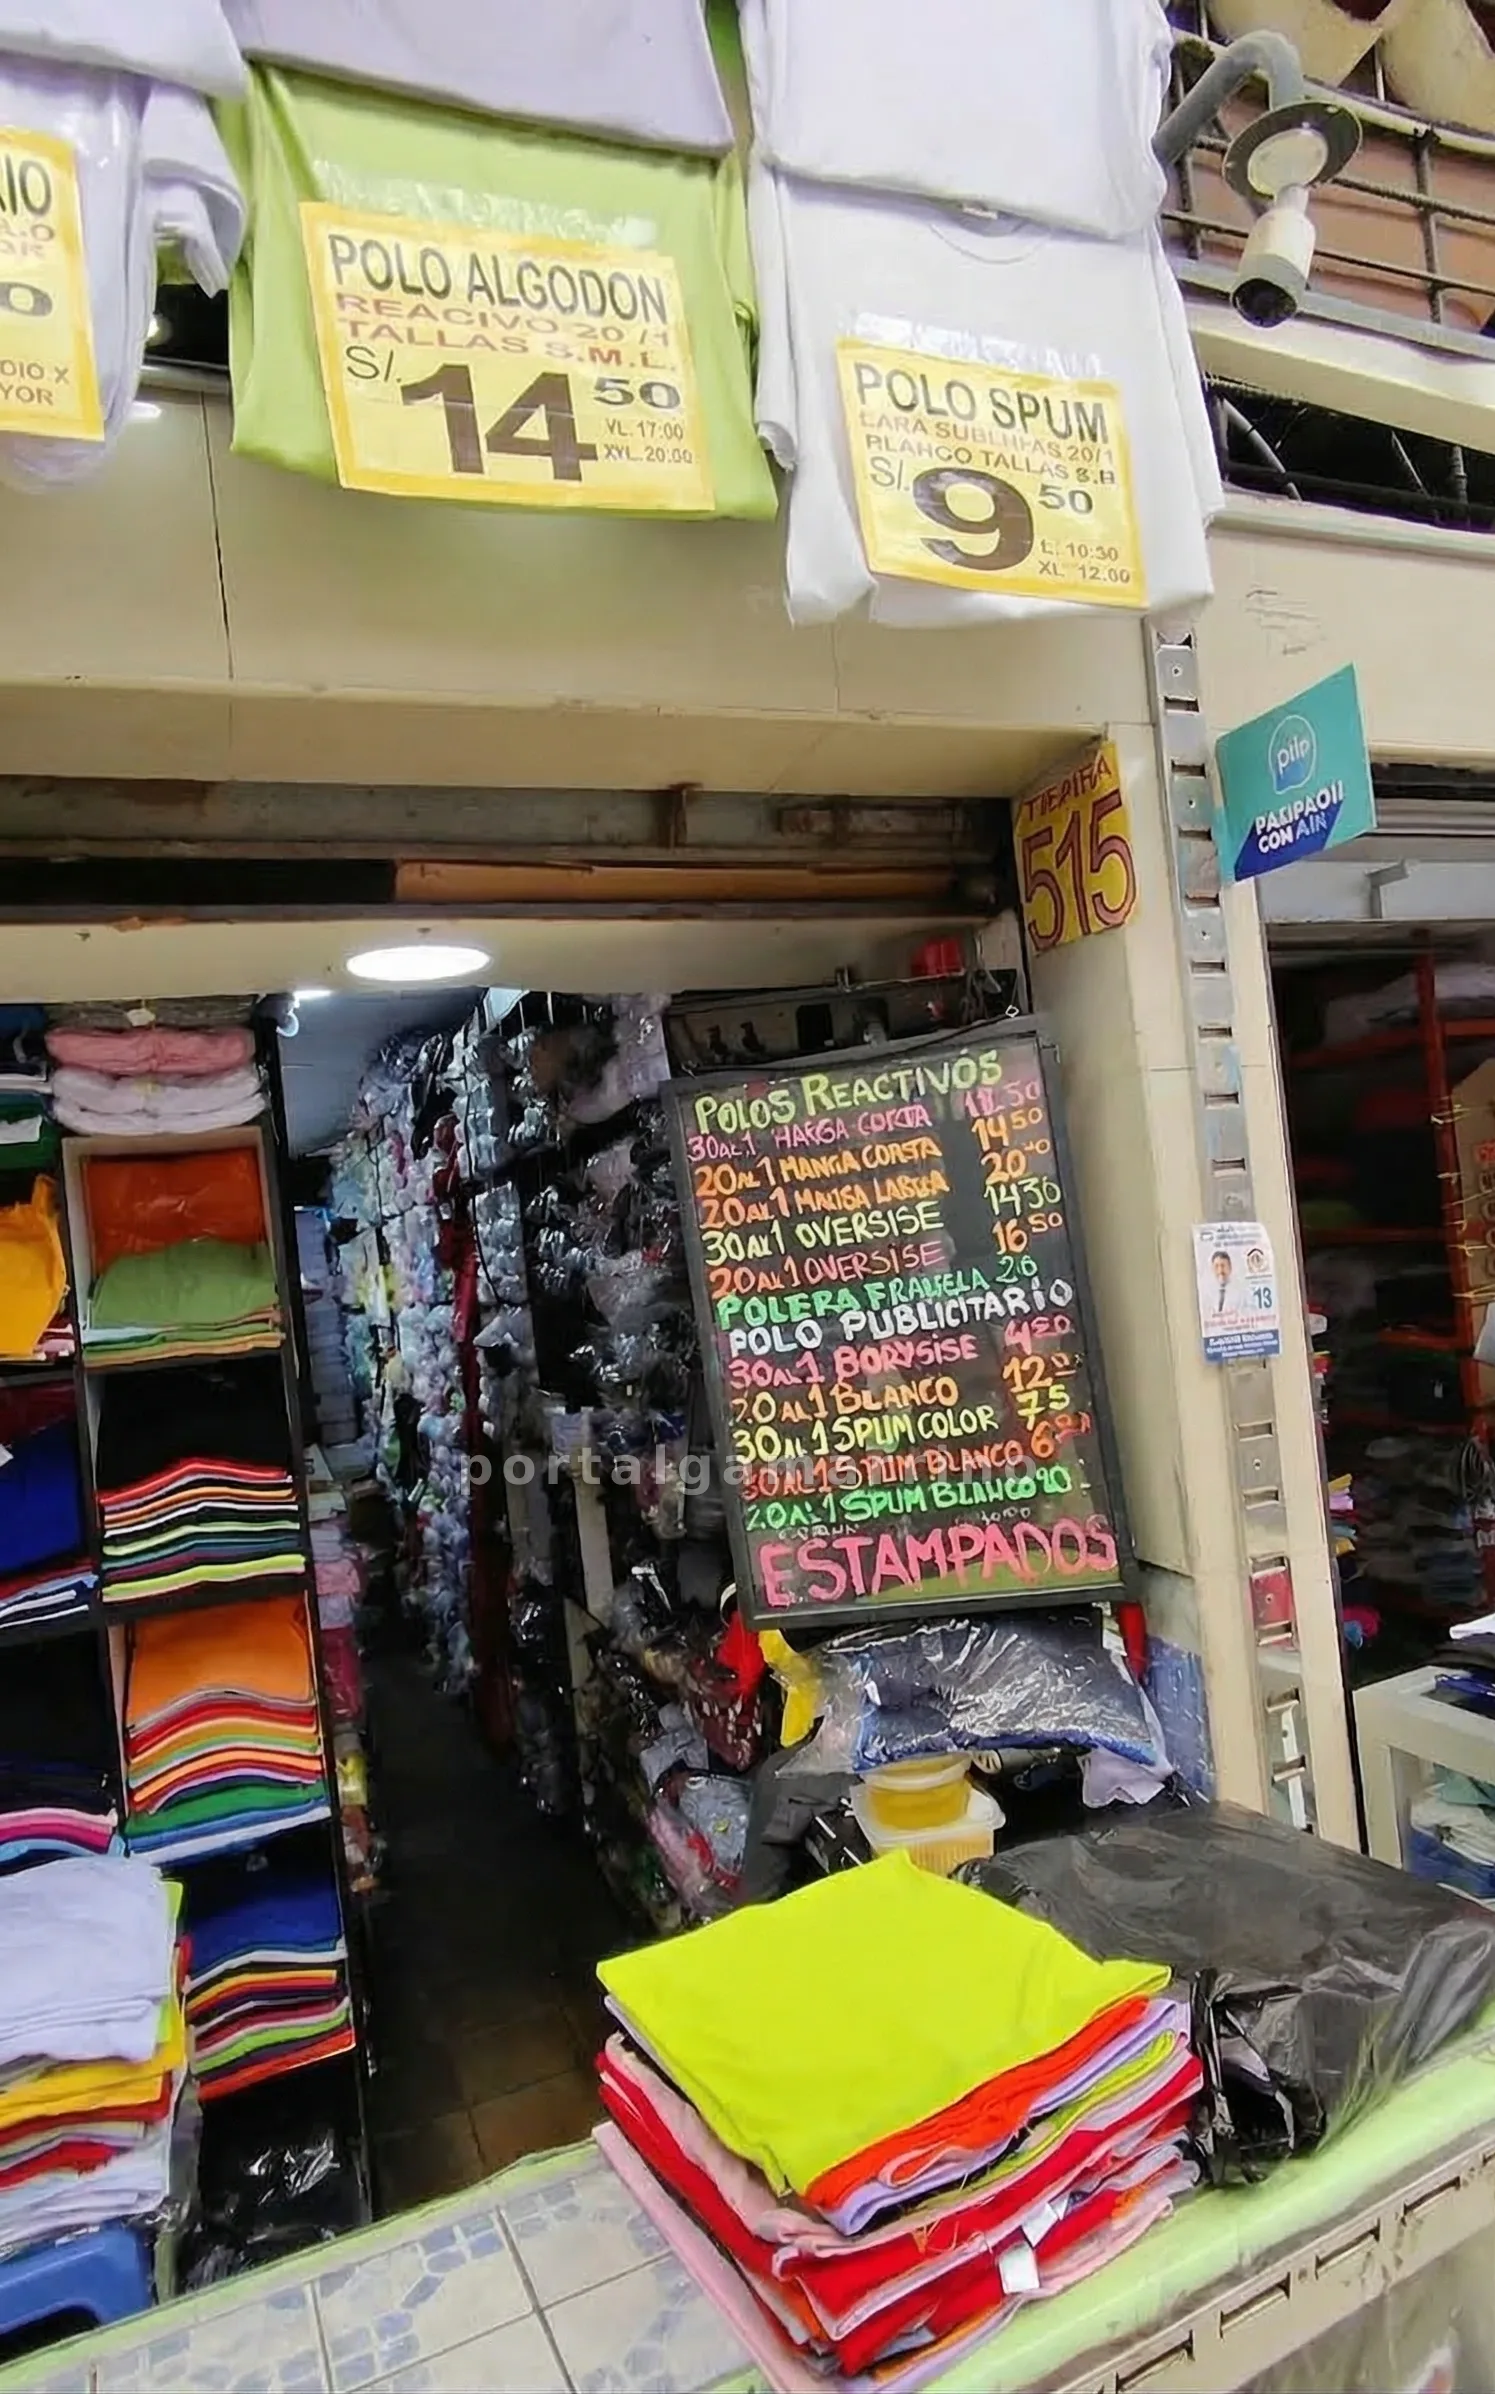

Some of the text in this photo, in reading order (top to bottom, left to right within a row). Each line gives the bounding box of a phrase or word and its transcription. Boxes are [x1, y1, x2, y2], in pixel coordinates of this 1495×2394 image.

[0, 153, 51, 217] IO
[328, 233, 668, 326] POLO ALGODON
[336, 292, 559, 335] REACIVO
[338, 317, 529, 355] TALLAS
[346, 345, 402, 383] S/.
[400, 363, 681, 482] 14 50
[854, 361, 1109, 445] POLO SPUM
[869, 456, 910, 492] S/.
[980, 450, 1069, 480] TALLAS
[912, 467, 1094, 571] 9 50
[1258, 826, 1295, 854] CON
[1020, 788, 1138, 956] 515
[695, 1051, 1002, 1135] POLOS REACTIVOS
[795, 1200, 944, 1249] OVERSISE
[716, 1287, 861, 1331] POLERA
[729, 1319, 823, 1358] POLO
[830, 1376, 959, 1416] BLANCO
[832, 1414, 915, 1452] SPUM
[917, 1405, 999, 1440] COLOR
[835, 1454, 918, 1490] SPUM
[926, 1440, 1023, 1475] BLANCO
[840, 1482, 927, 1522] SPUM
[759, 1514, 1118, 1606] ESTAMPADOS
